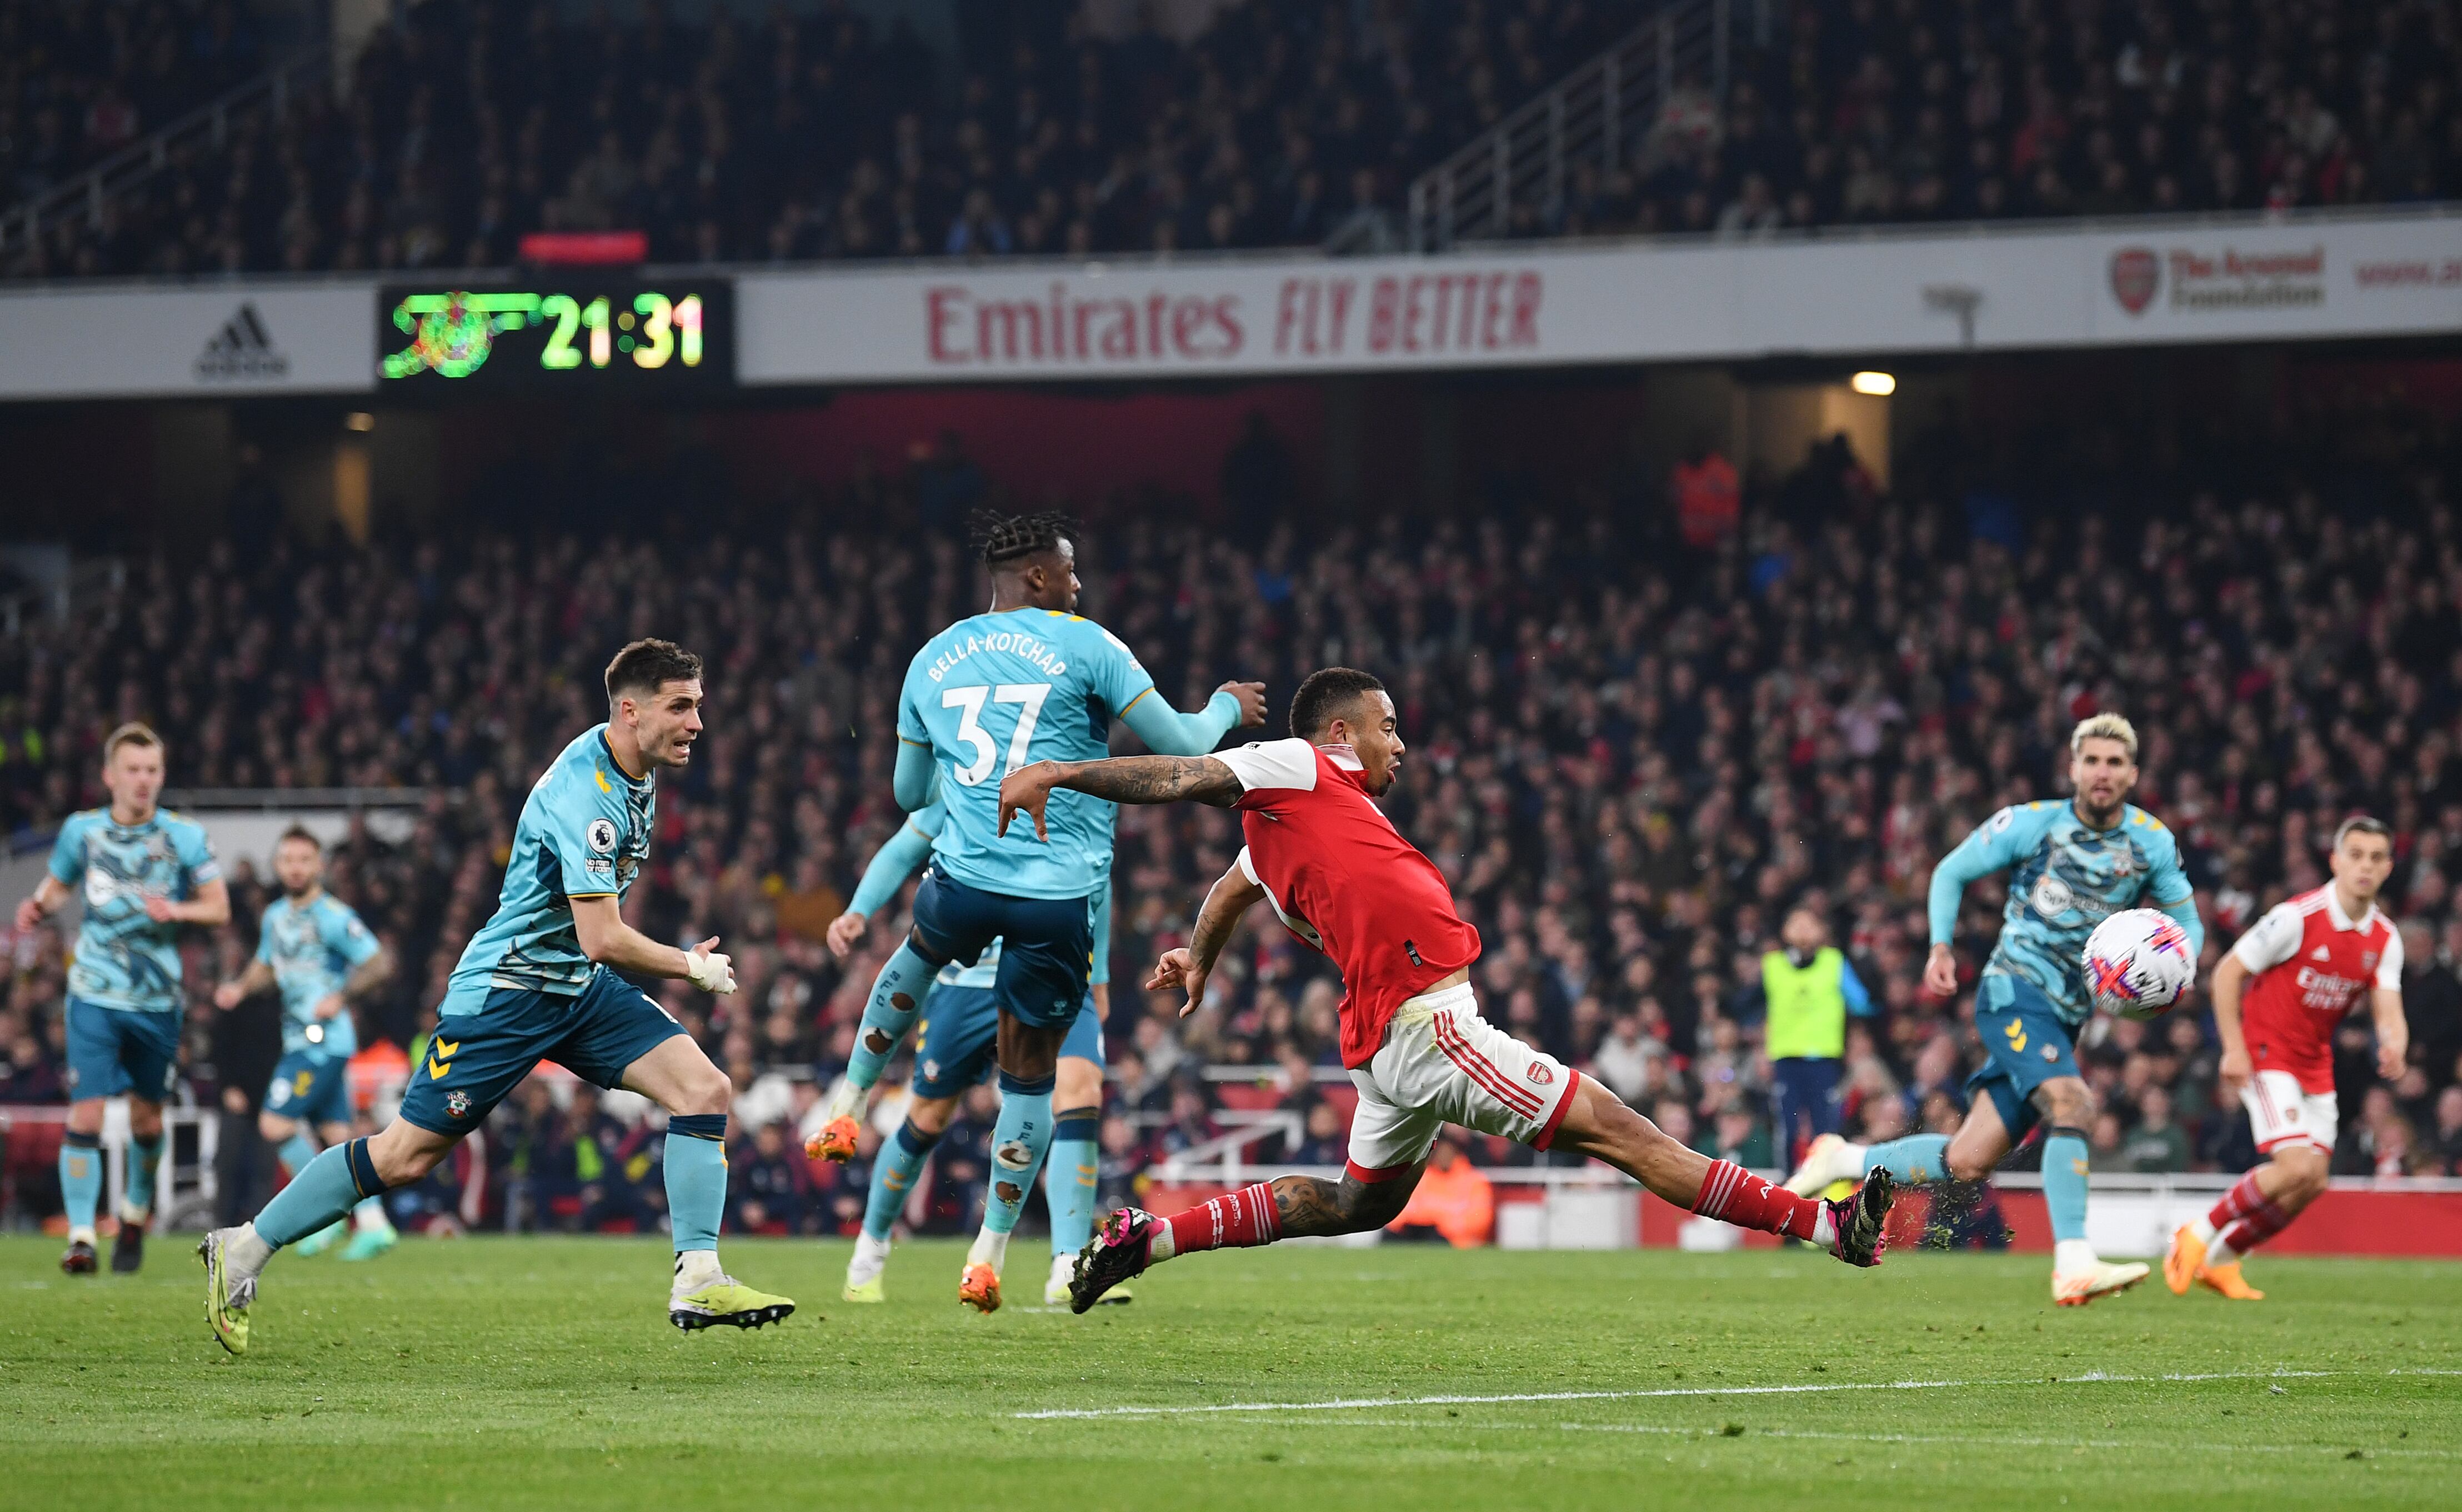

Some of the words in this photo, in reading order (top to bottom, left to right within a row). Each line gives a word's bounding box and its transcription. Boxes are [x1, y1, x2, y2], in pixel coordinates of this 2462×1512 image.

[541, 293, 702, 369] 21:31
[926, 281, 1245, 362] Emirates
[1274, 277, 1355, 356] FLY
[1367, 272, 1543, 354] BETTER
[928, 632, 1067, 683] BELLA-KOTCHAP
[942, 683, 1052, 787] 37
[586, 858, 595, 867] No
